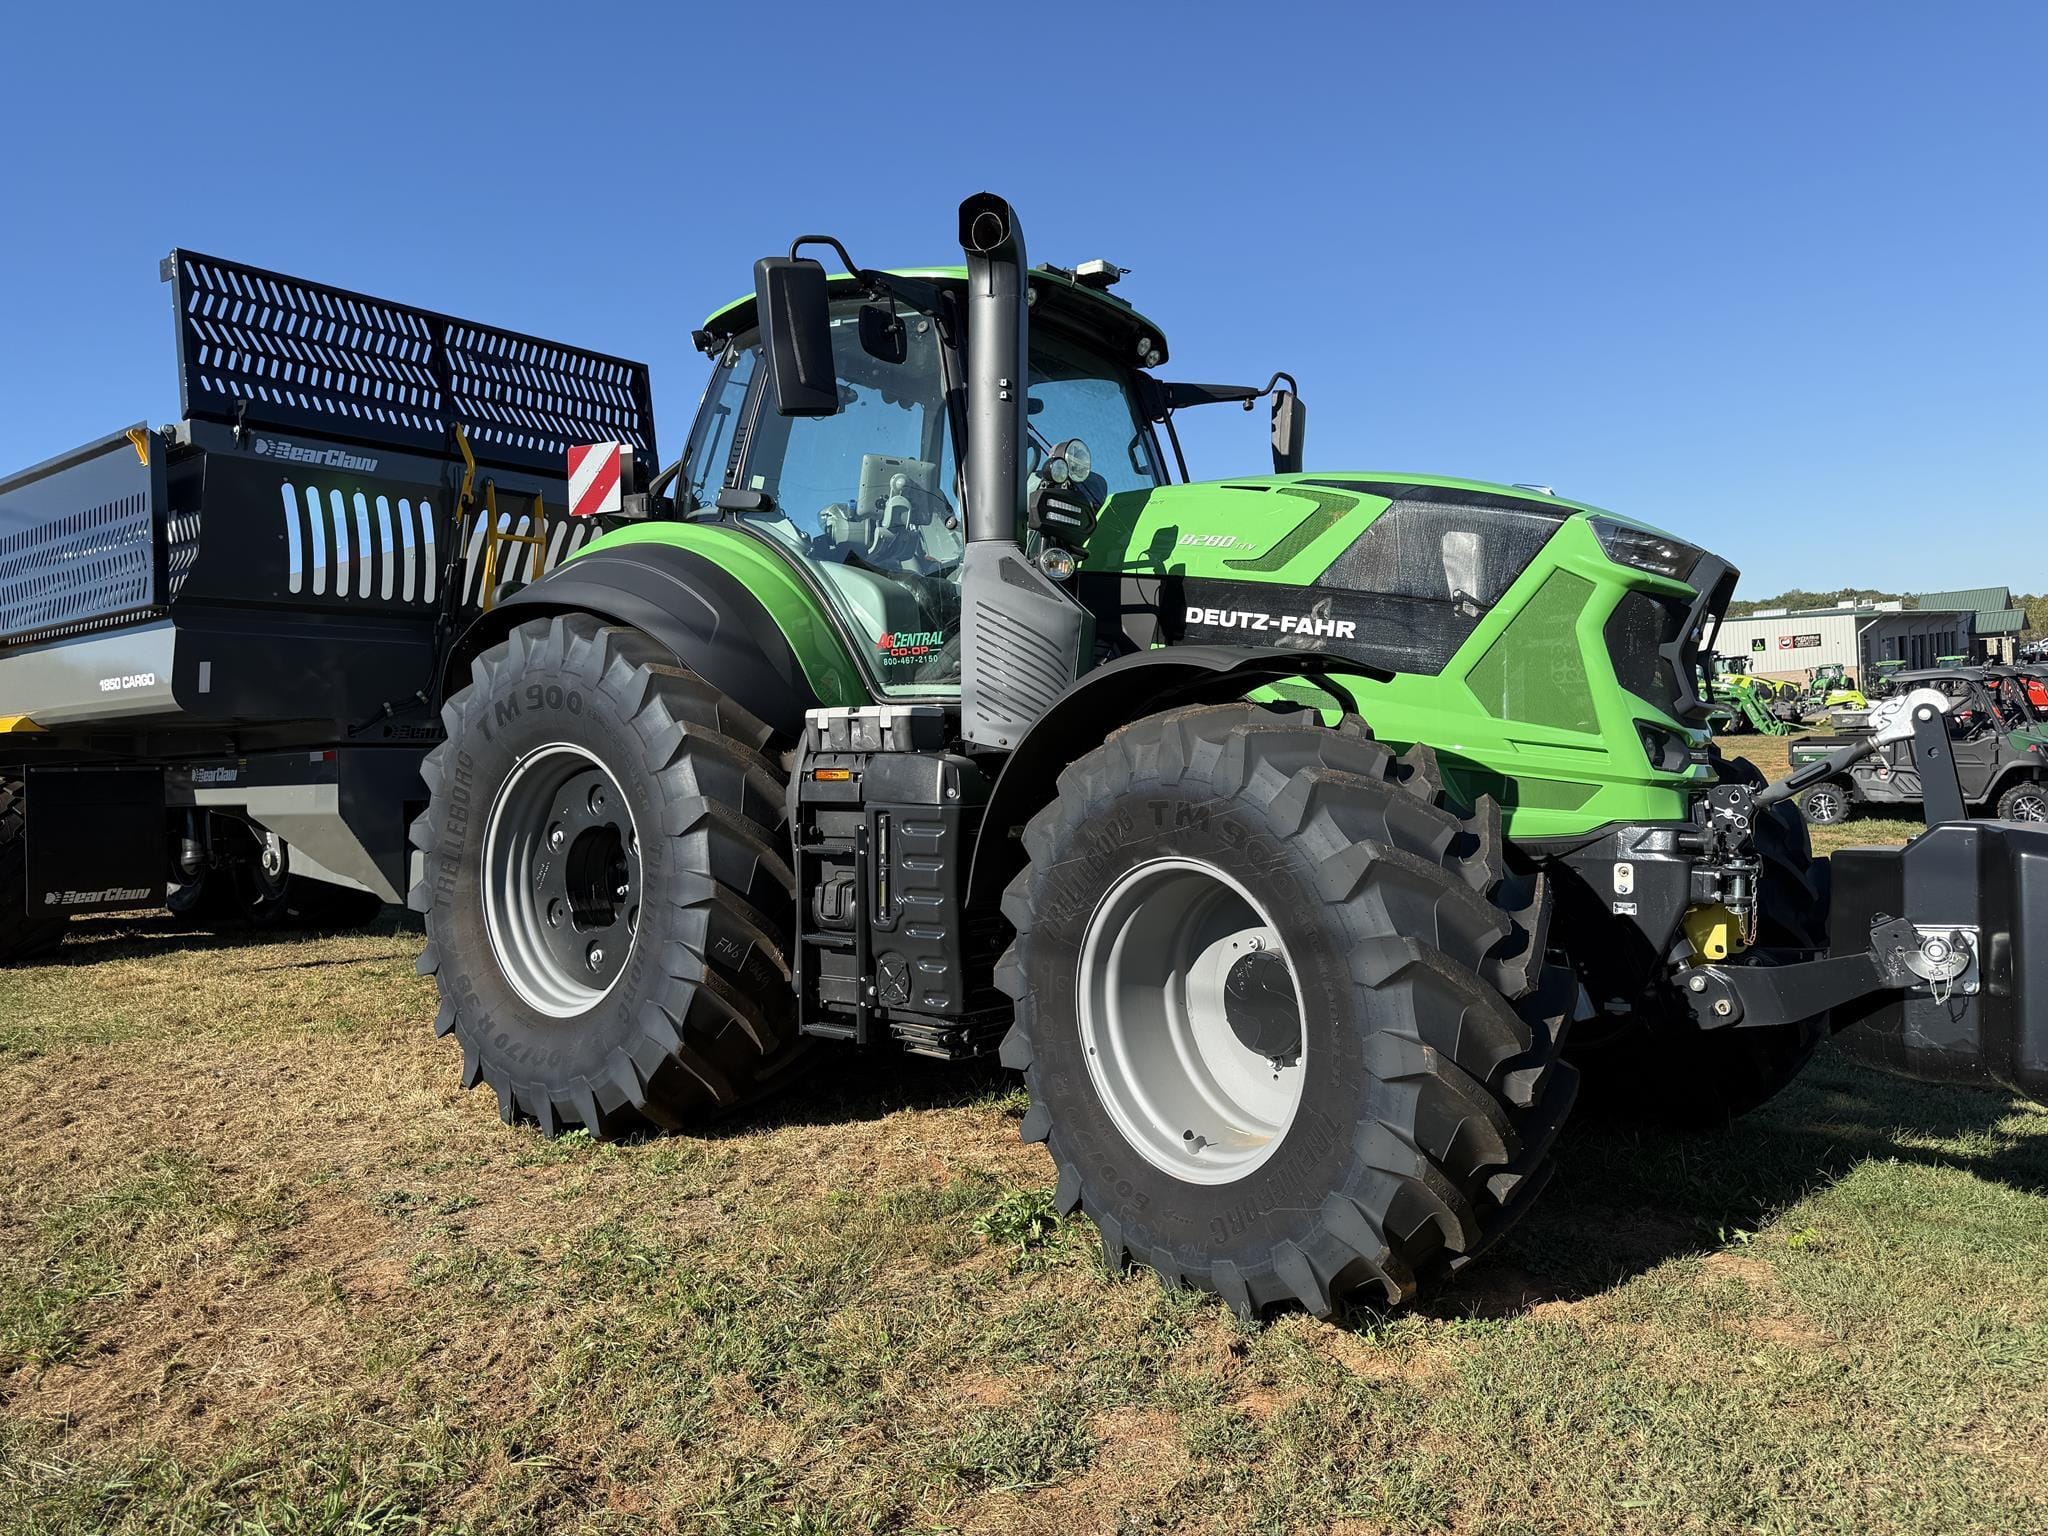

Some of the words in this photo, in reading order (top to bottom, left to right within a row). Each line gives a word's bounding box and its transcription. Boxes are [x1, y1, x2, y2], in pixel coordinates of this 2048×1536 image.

[274, 441, 378, 472] BearClaw
[1185, 606, 1357, 639] DEUTZ-FAHR
[99, 677, 121, 691] 1850
[122, 672, 155, 689] CARGO
[525, 684, 583, 716] 900
[61, 888, 151, 904] BearClaw
